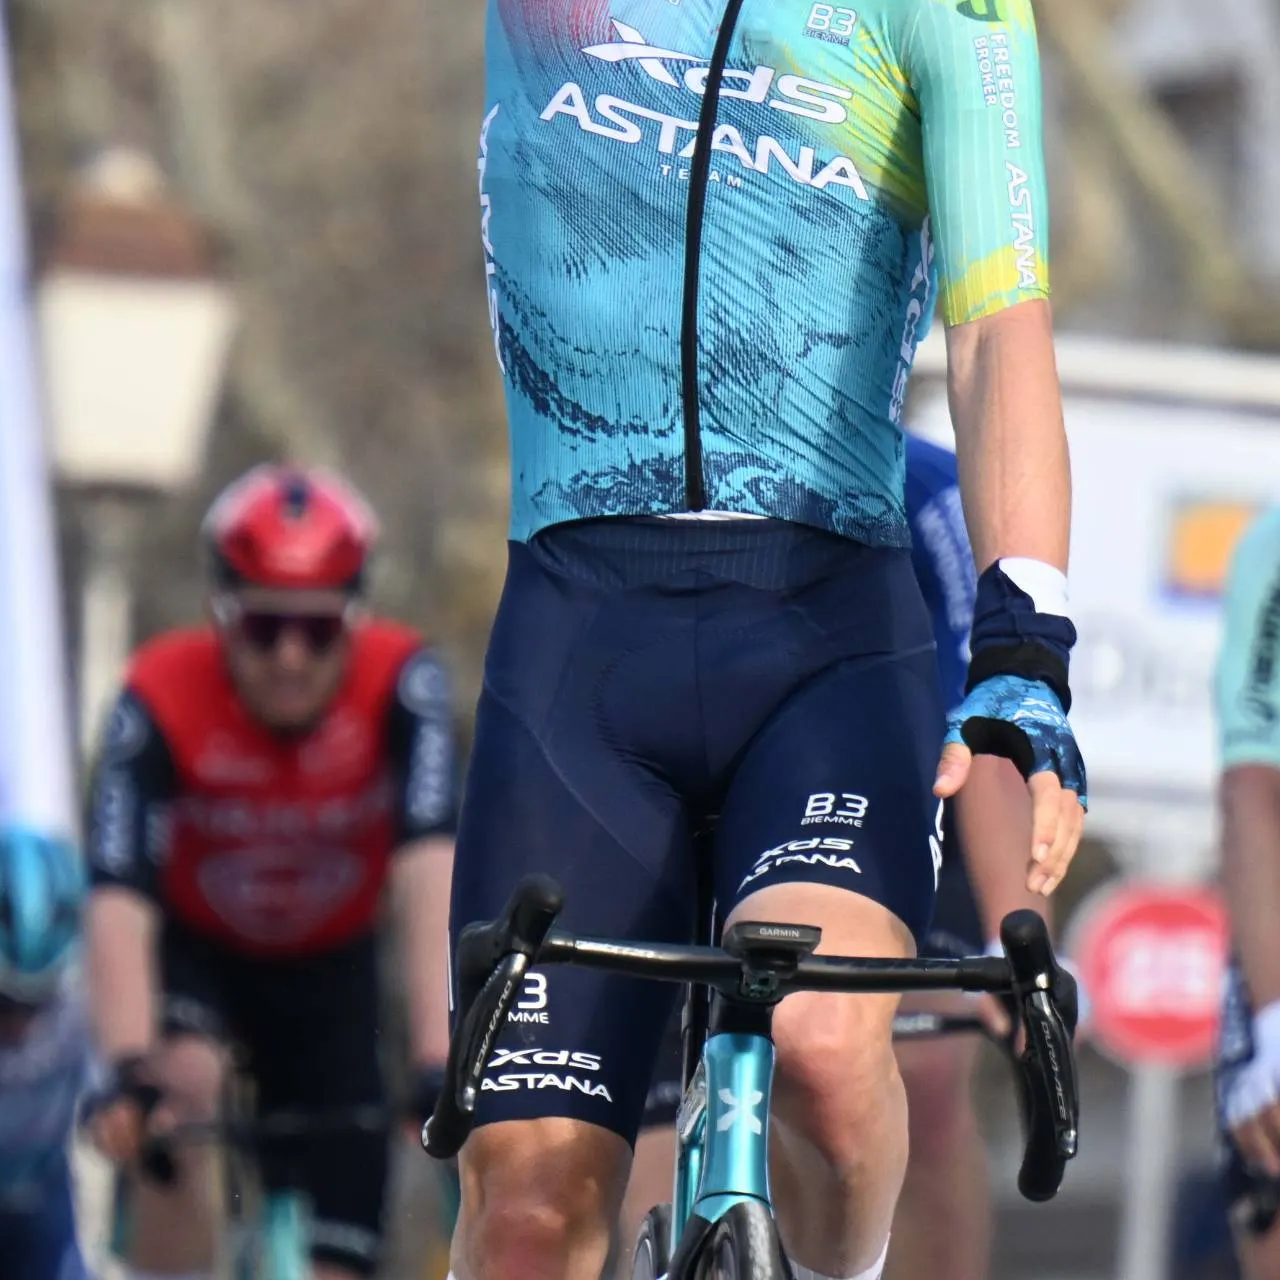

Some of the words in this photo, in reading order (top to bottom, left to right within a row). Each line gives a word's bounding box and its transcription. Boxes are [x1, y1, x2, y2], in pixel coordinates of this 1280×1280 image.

[806, 2, 857, 37] B3
[974, 35, 998, 107] BROKER
[539, 81, 870, 201] ASTANA
[660, 164, 742, 188] TEAM
[990, 33, 1020, 149] FREEDOM
[1005, 160, 1036, 289] ASTANA
[801, 815, 863, 828] BIEMME
[804, 793, 869, 819] B3
[736, 854, 862, 895] ASTANA
[759, 927, 801, 938] GARMIN
[481, 1073, 613, 1103] ASTANA
